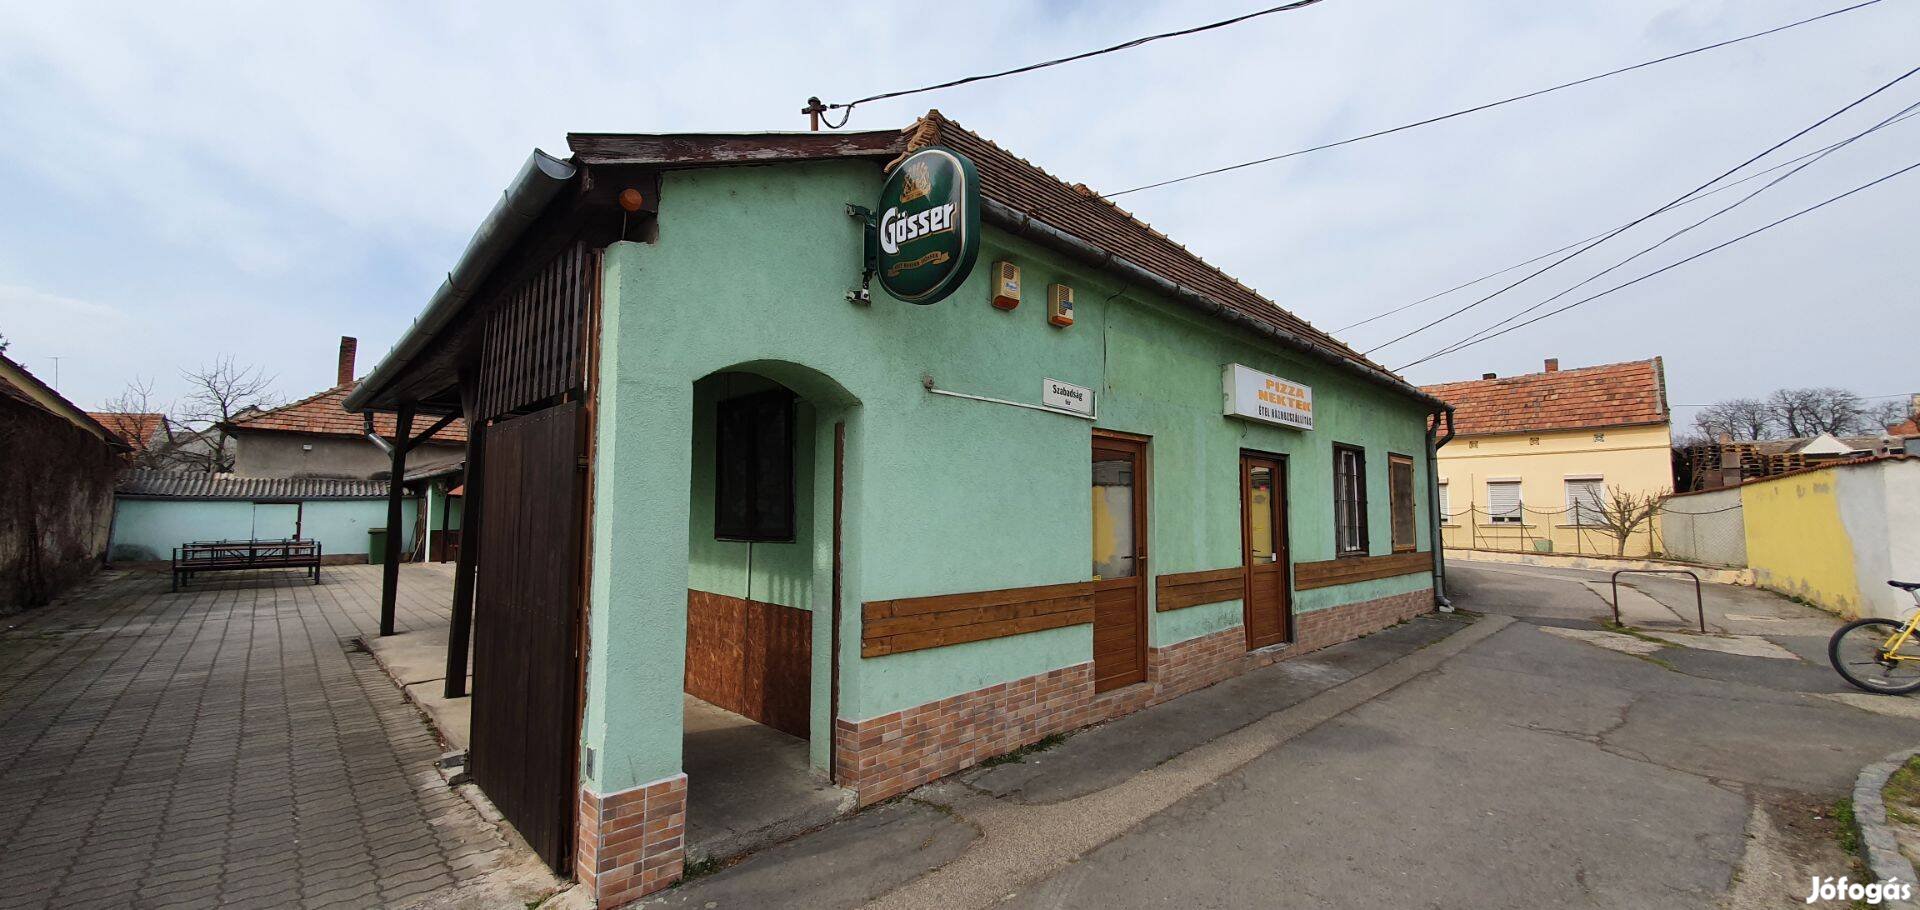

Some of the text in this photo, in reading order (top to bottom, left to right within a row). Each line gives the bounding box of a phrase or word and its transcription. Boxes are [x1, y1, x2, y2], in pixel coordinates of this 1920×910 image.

[880, 203, 956, 254] Gösser
[1052, 384, 1083, 402] Szabadság
[1265, 379, 1304, 398] PIZZA
[1258, 390, 1311, 412] NEKTEK
